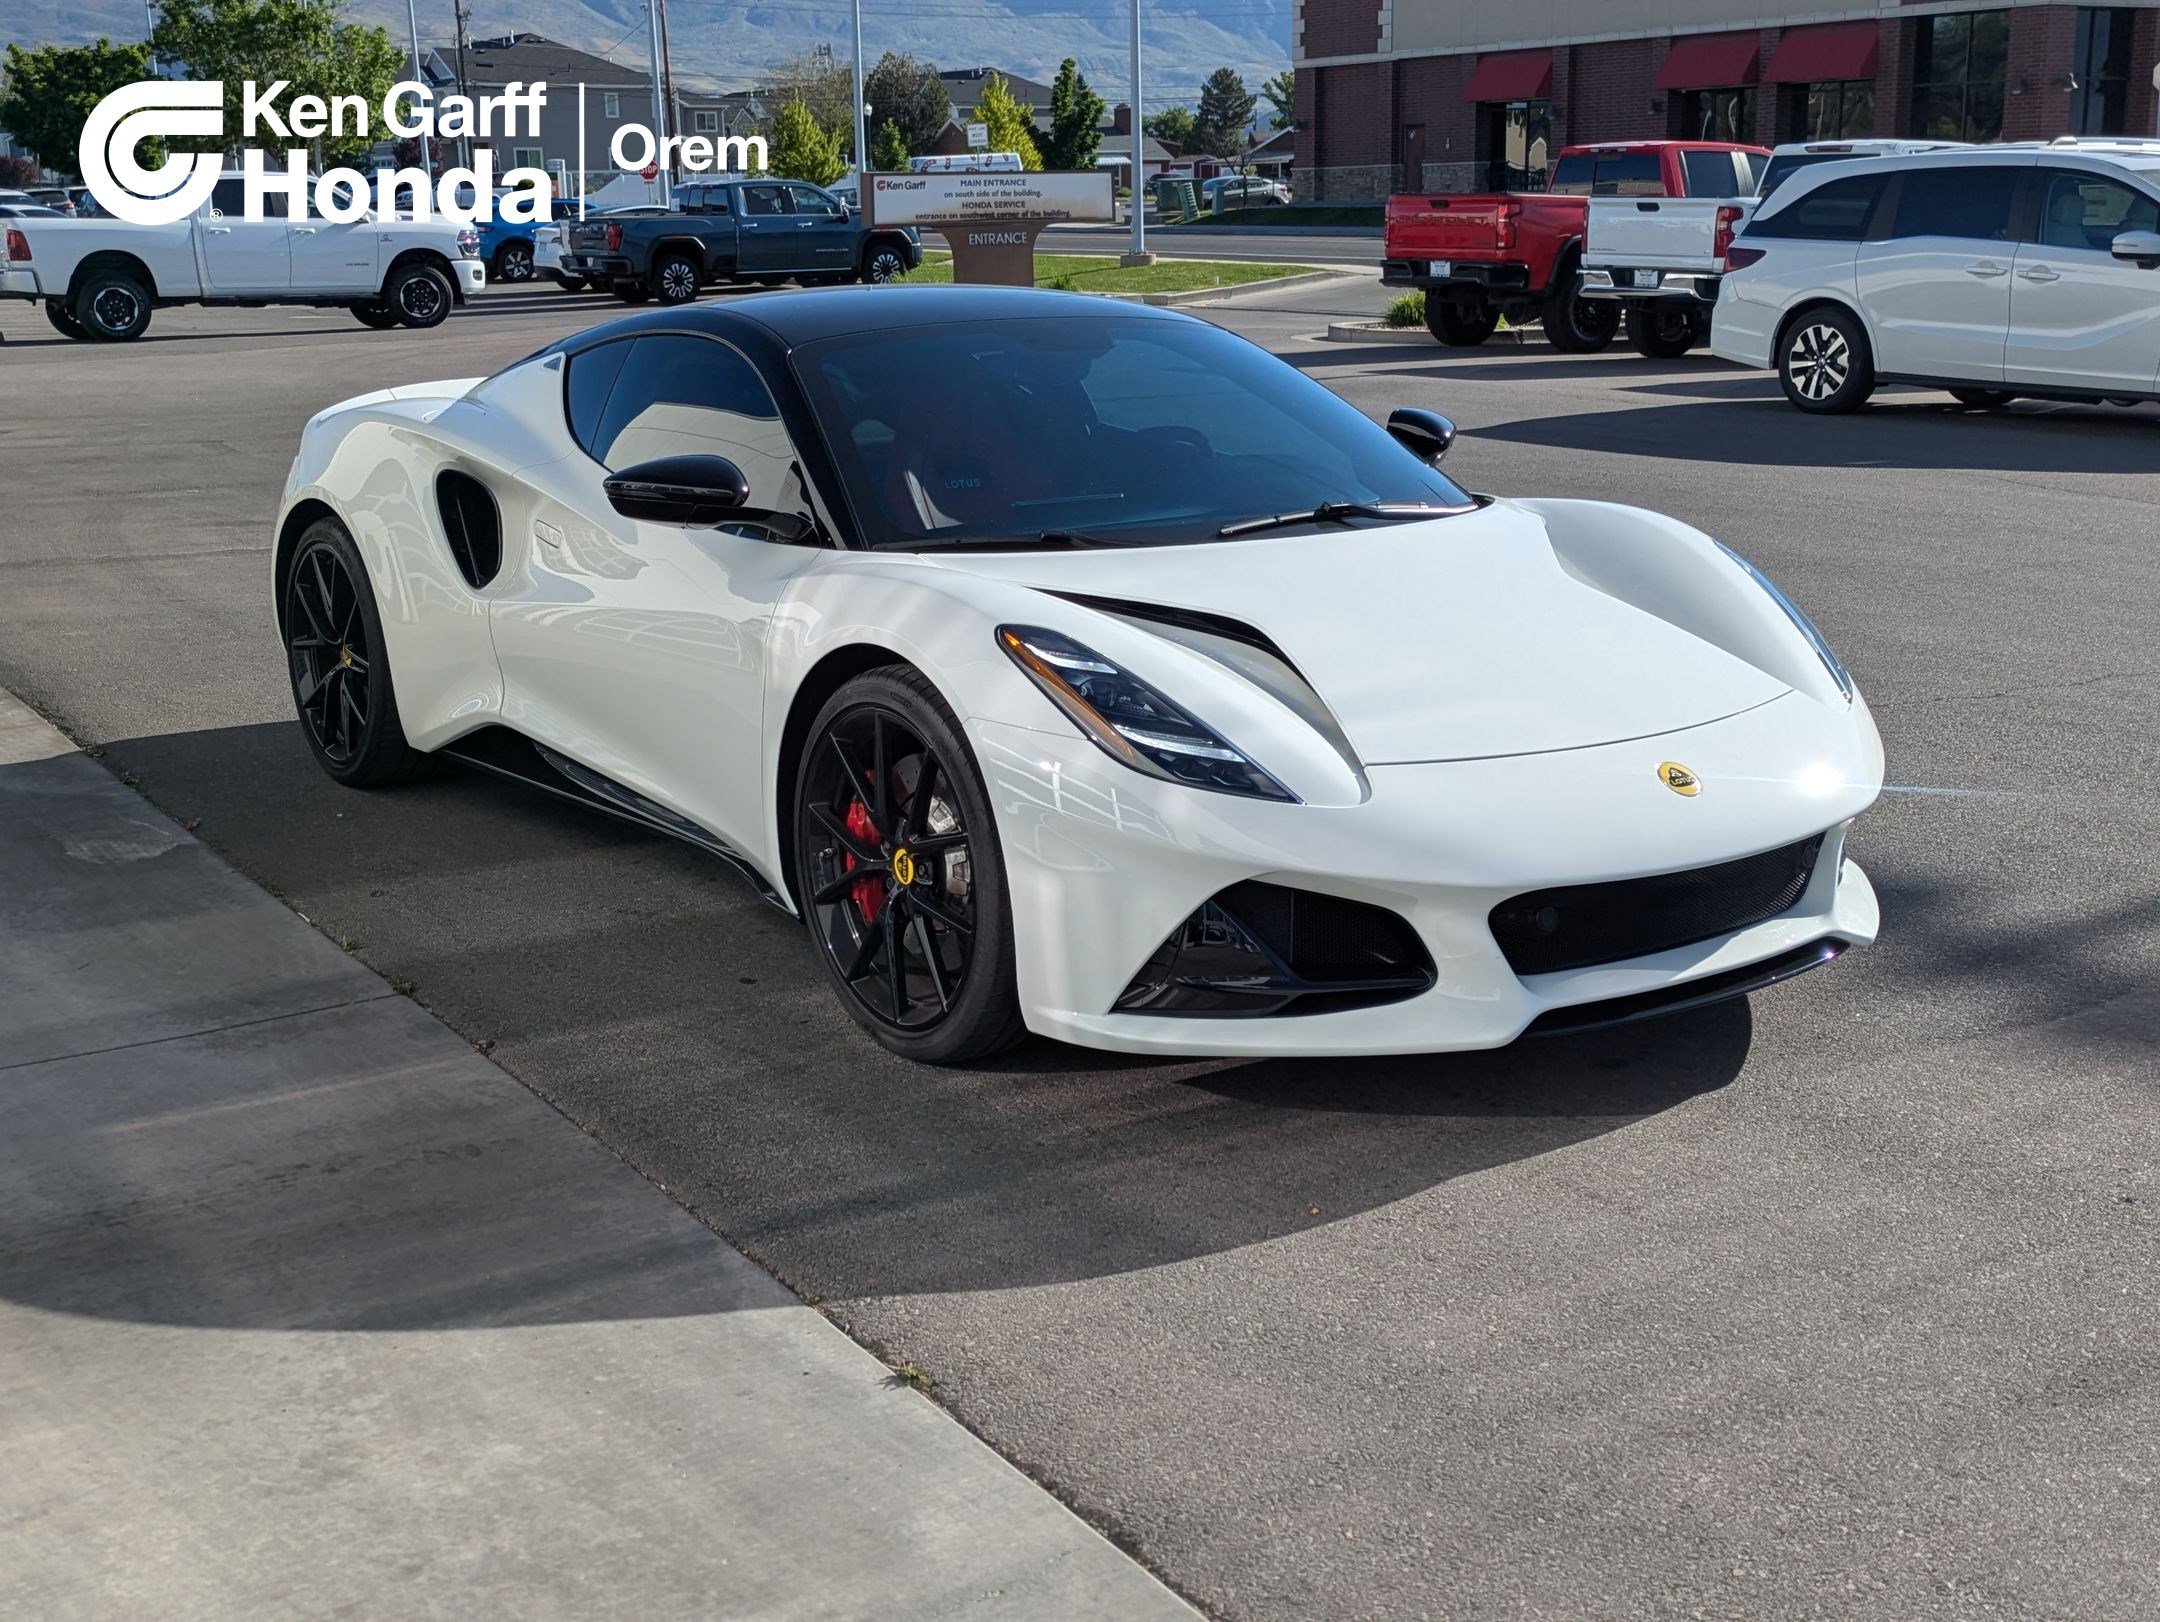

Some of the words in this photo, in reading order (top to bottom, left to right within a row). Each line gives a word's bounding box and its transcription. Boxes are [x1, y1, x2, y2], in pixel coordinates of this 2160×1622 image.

[886, 180, 904, 191] Ken
[904, 180, 926, 191] Garff
[960, 179, 981, 187] MAIN
[983, 178, 1027, 187] ENTRANCE
[954, 190, 975, 198] south
[976, 190, 990, 198] side
[1013, 189, 1043, 198] building.
[961, 201, 992, 209] HONDA
[994, 200, 1026, 209] SERVICE
[915, 212, 947, 220] entrance
[1021, 210, 1029, 218] of
[1043, 209, 1072, 218] building.
[968, 231, 1028, 246] ENTRANCE
[944, 478, 981, 489] LOTUS
